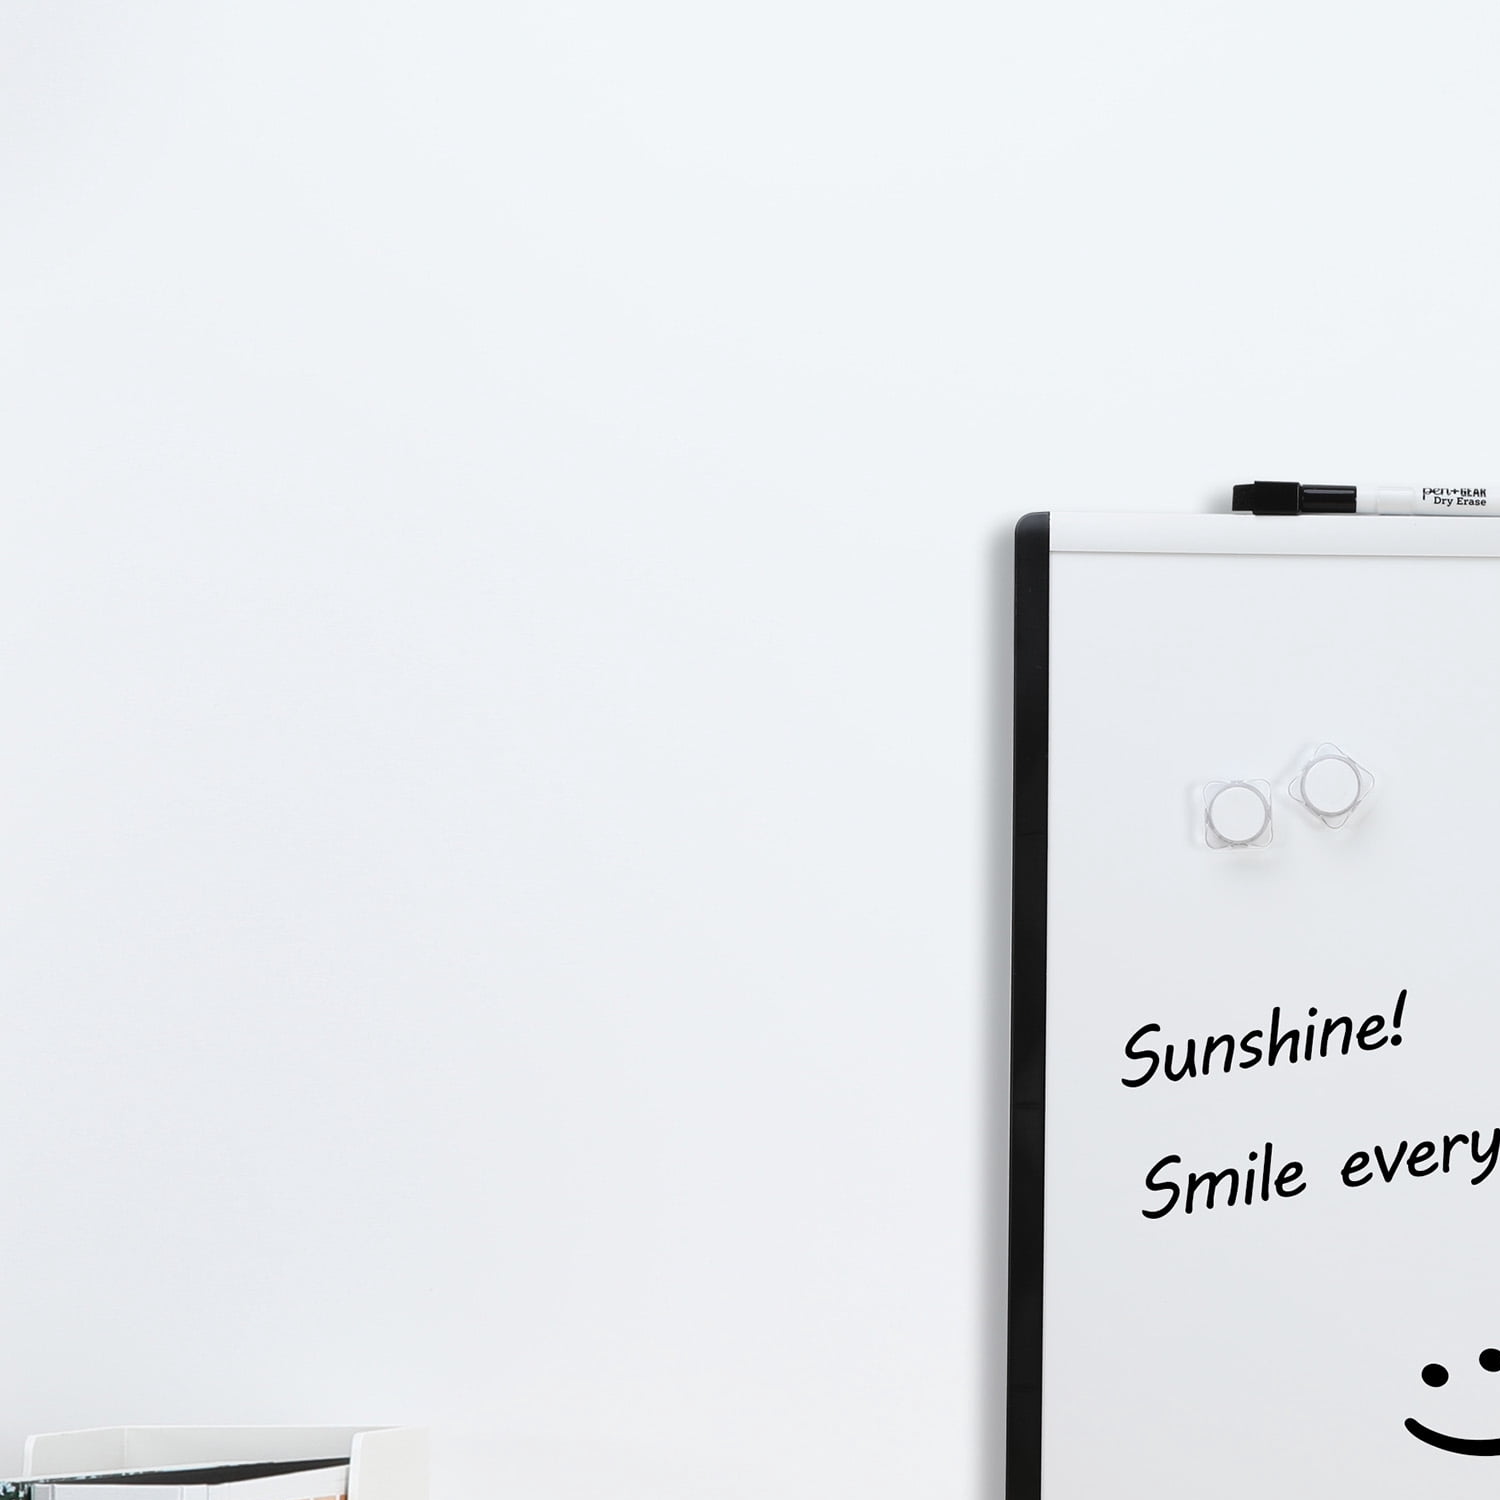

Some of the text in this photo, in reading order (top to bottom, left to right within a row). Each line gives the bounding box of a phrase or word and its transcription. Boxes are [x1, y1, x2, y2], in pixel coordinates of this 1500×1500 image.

[1433, 496, 1487, 507] Dry Erase
[1121, 988, 1408, 1088] Sunshine!
[1141, 1142, 1307, 1220] Smile
